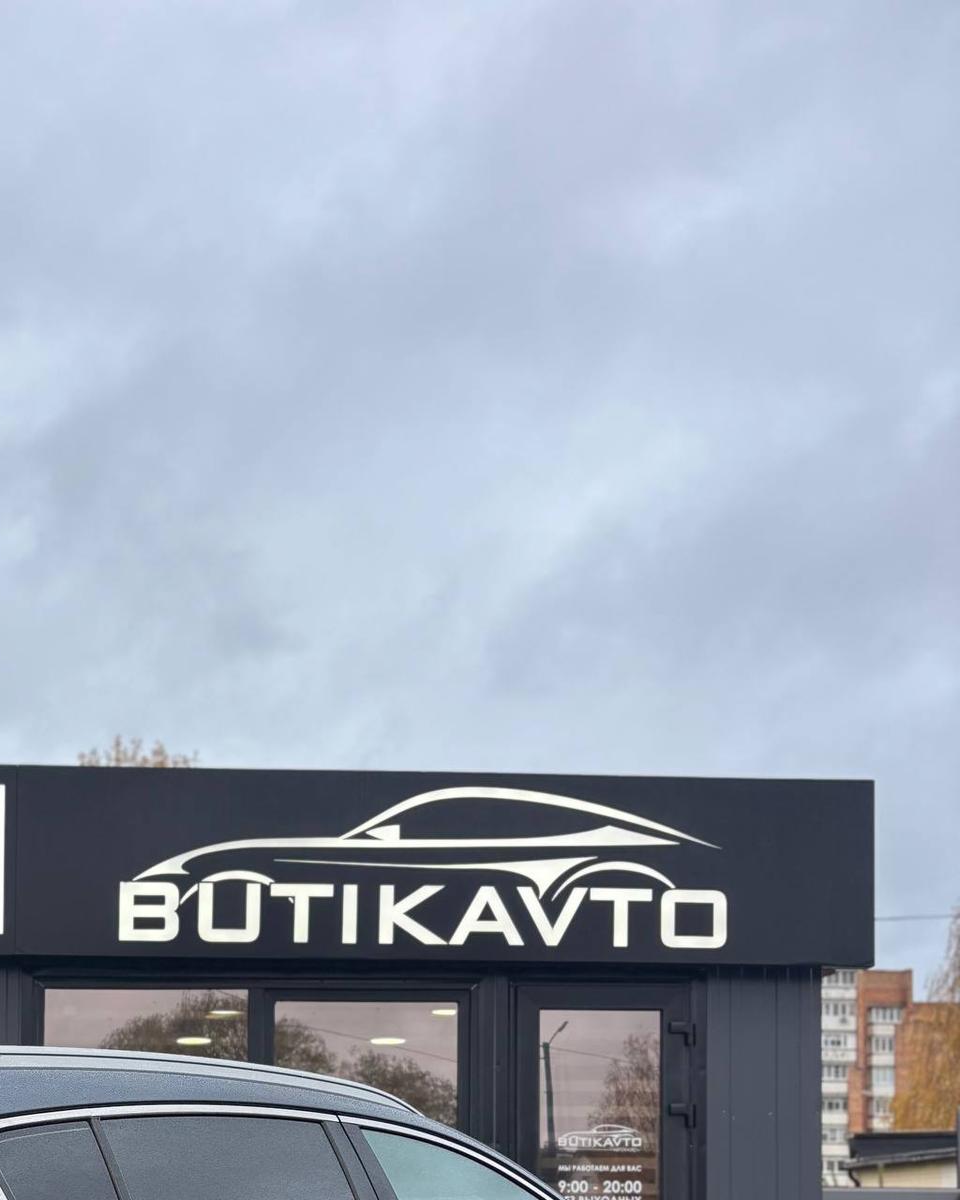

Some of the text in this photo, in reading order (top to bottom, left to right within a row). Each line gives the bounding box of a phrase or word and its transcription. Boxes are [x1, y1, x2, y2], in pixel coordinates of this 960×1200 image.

[118, 881, 728, 949] BUTIKAVTO
[557, 1137, 642, 1148] BUTIKAVTO
[610, 1165, 625, 1173] ДЛЯ
[558, 1180, 588, 1193] 9:00
[603, 1180, 642, 1194] 20:00
